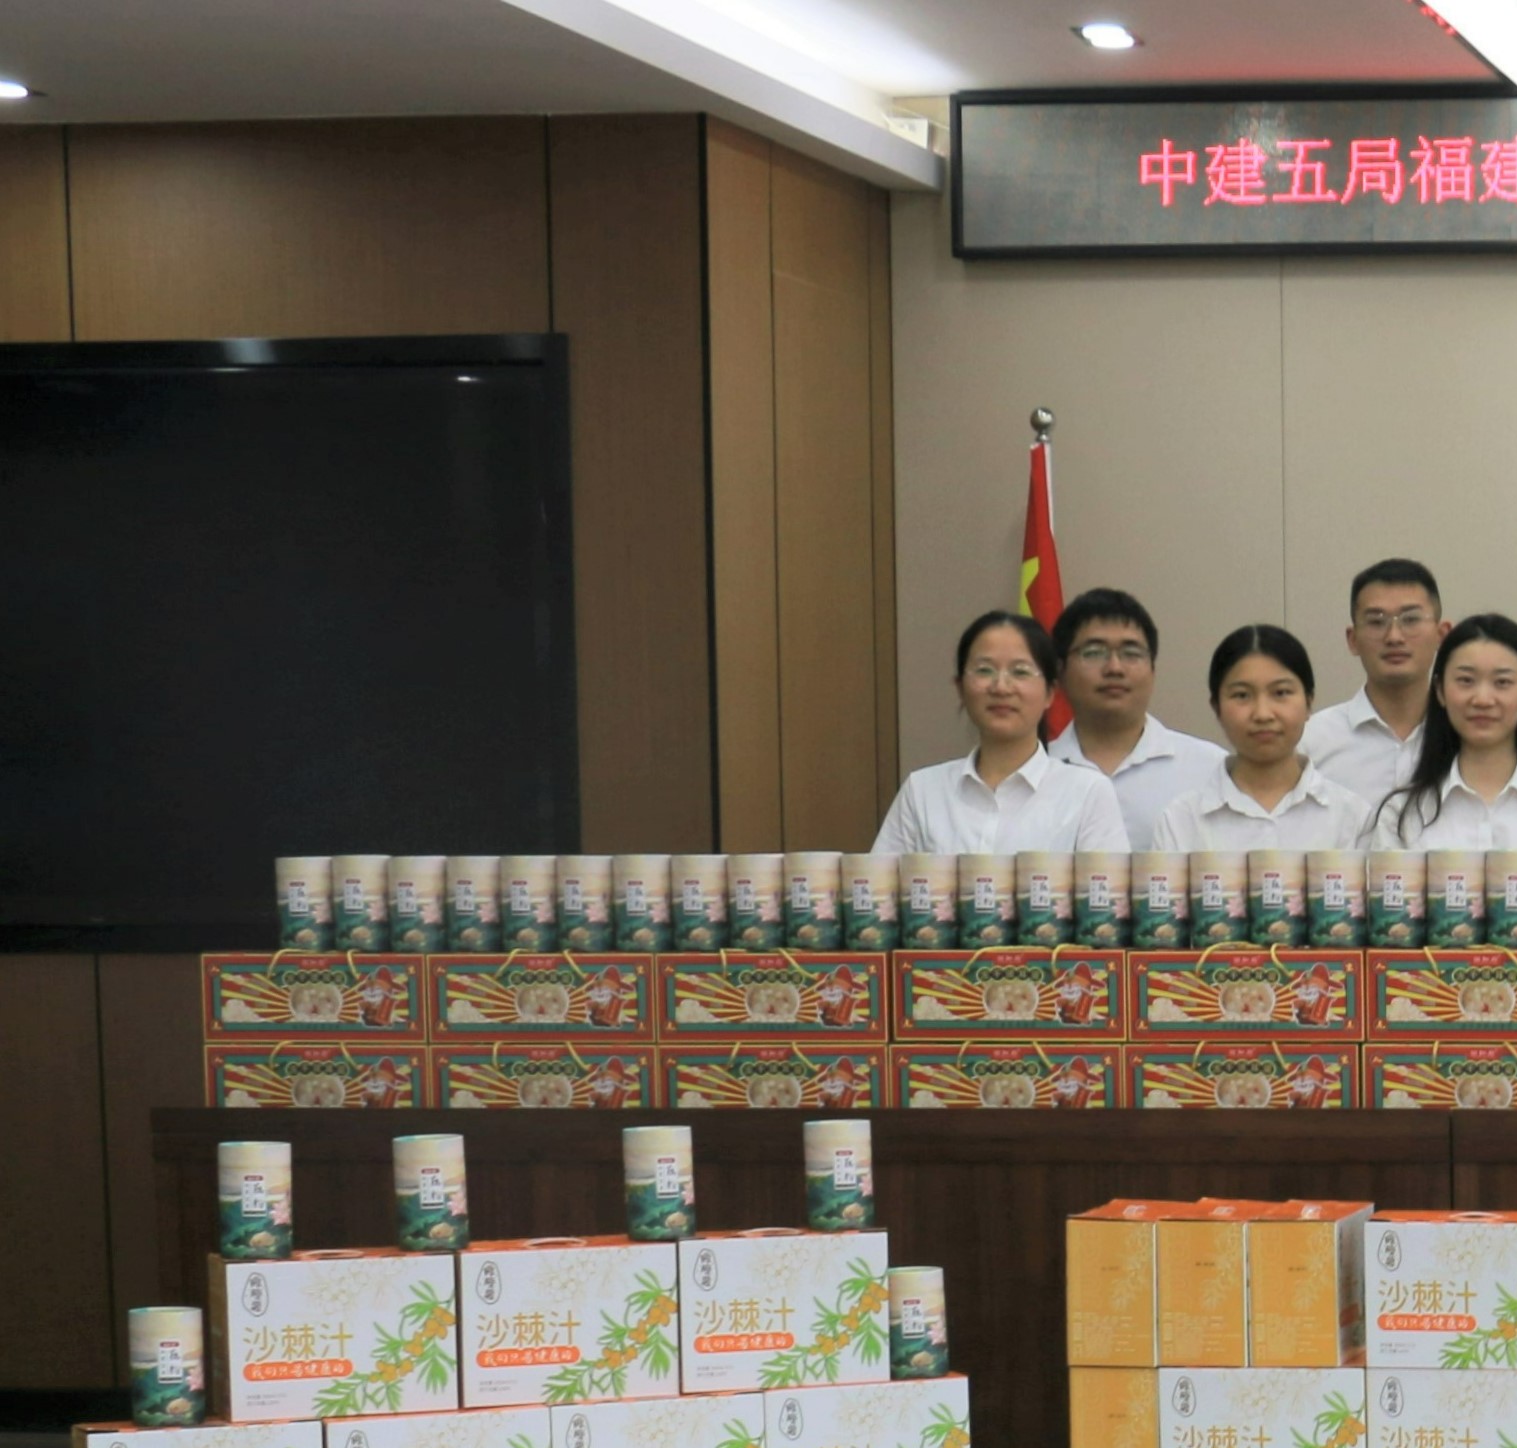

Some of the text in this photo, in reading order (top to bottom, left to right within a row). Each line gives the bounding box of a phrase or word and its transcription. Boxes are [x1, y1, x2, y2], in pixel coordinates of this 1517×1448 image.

[1378, 1281, 1476, 1317] 沙棘汁
[477, 1312, 580, 1349] 沙棘汁
[695, 1300, 794, 1337] 沙棘汁
[244, 1323, 353, 1361] 沙棘汁
